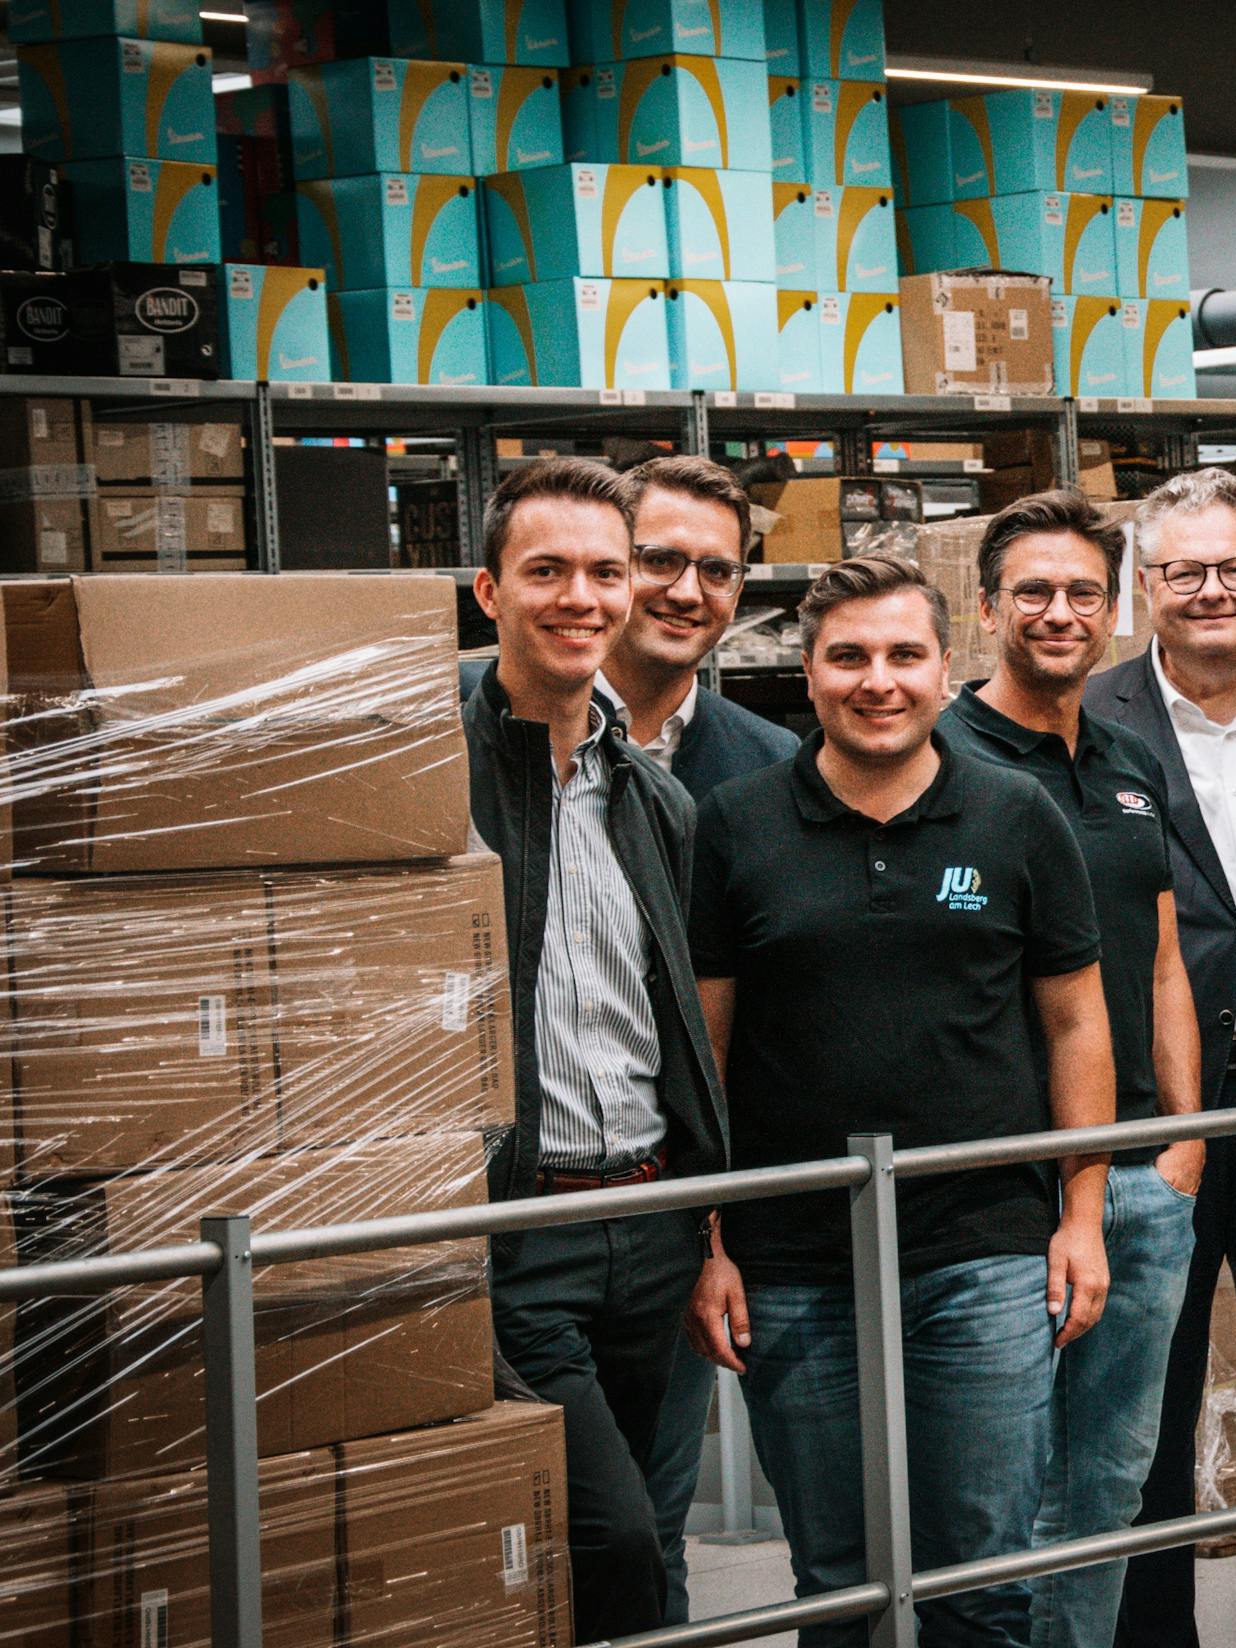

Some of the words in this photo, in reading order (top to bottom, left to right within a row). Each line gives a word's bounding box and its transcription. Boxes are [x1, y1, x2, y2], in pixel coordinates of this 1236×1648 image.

[26, 305, 62, 325] BANDIT
[146, 296, 188, 316] BANDIT
[935, 867, 974, 902] JU
[949, 893, 988, 905] Landsberg
[949, 902, 962, 910] am
[963, 902, 982, 911] Lech
